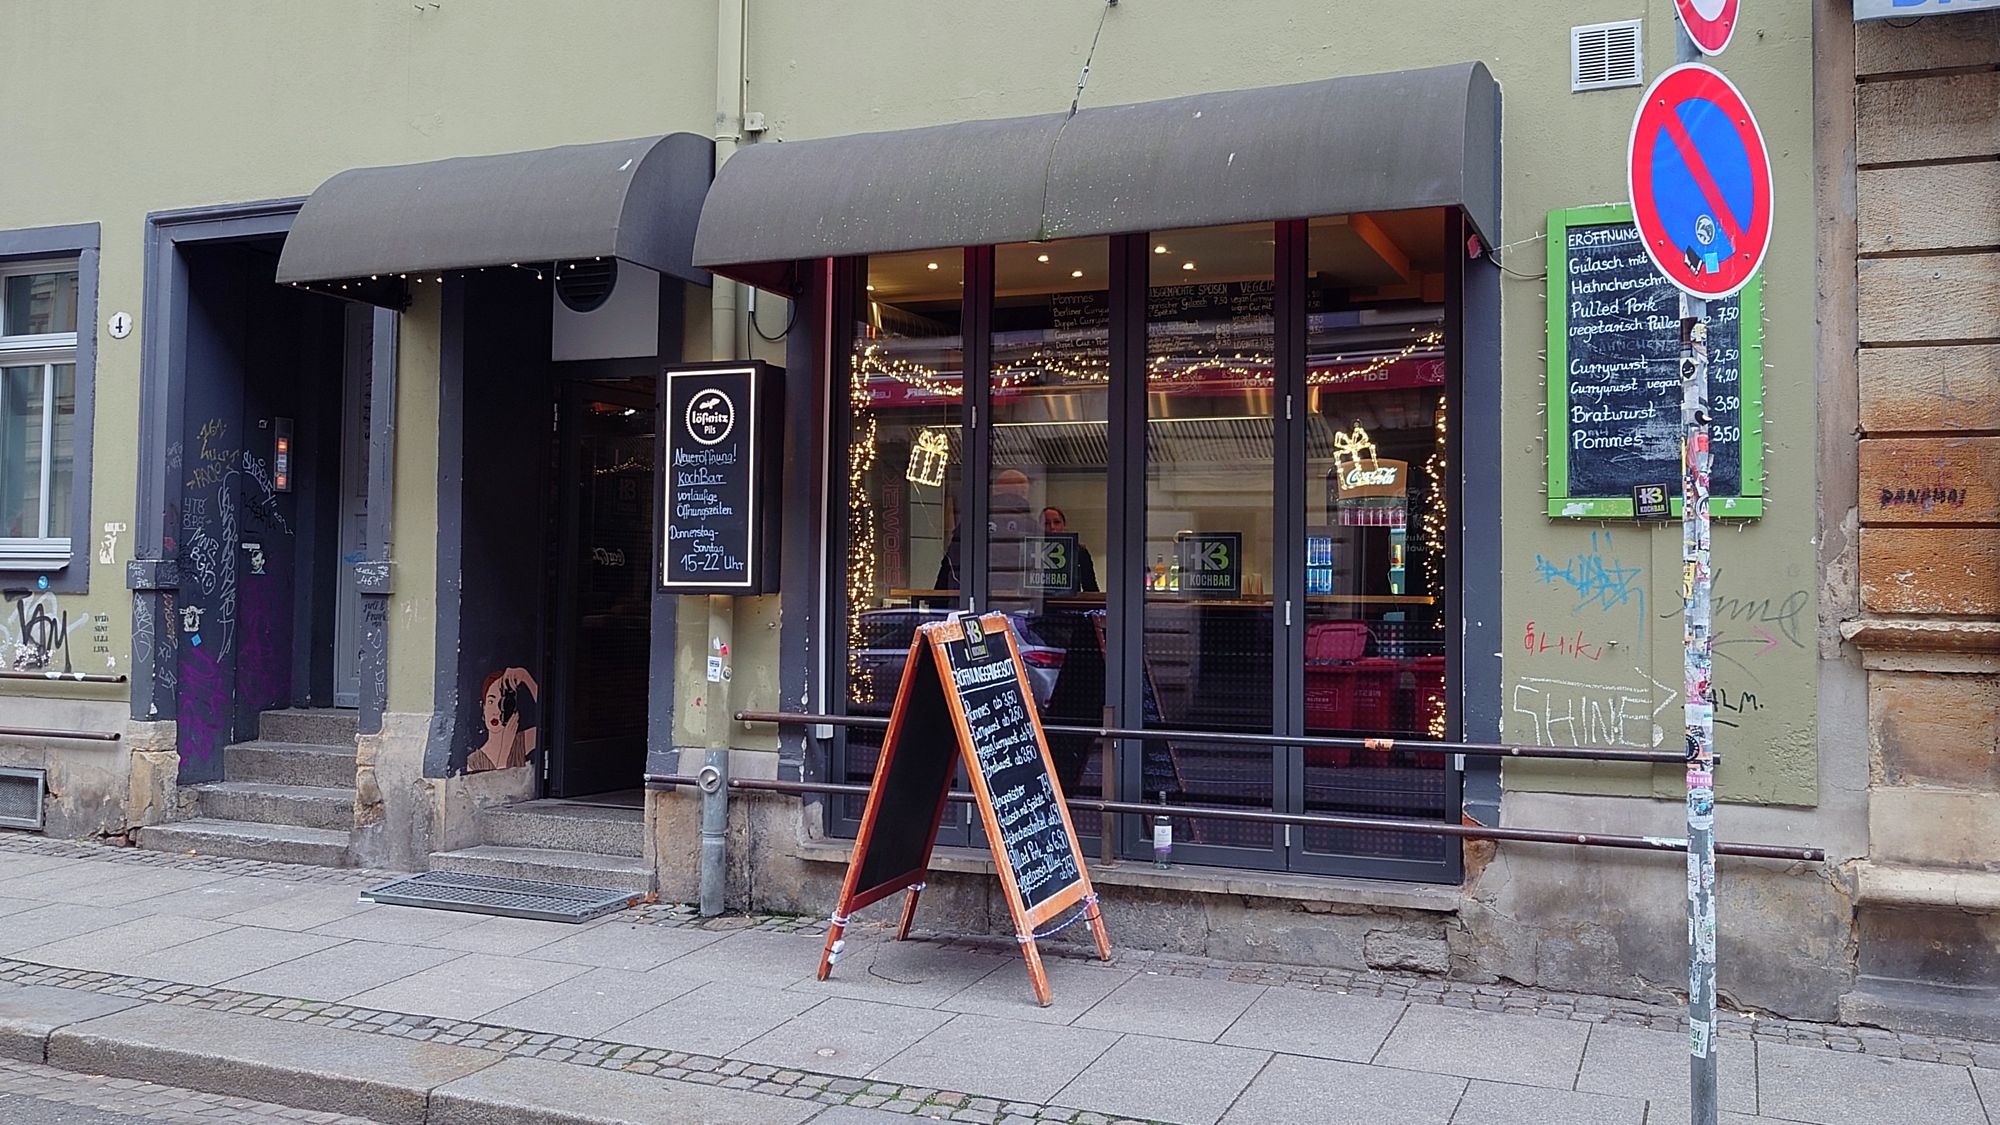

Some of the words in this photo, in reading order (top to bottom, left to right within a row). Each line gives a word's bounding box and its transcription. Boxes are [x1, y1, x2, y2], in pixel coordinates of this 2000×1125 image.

[1568, 228, 1639, 247] ERÖFFNUNG
[1569, 255, 1624, 274] Gulasch
[1628, 252, 1648, 266] mit
[1571, 273, 1671, 295] Hähnchenschn
[1571, 298, 1619, 318] Pulled
[1625, 296, 1658, 315] Pork
[1569, 318, 1643, 343] vegetarisch
[1717, 307, 1739, 323] 7,50
[1570, 354, 1648, 382] Currywurst
[1713, 350, 1739, 363] 2,50
[1570, 378, 1638, 404] Currywurst
[1647, 380, 1682, 395] vegan
[1715, 368, 1738, 382] 4,20
[1571, 401, 1656, 423] Bratwurst
[1714, 396, 1740, 413] 3,50
[704, 425, 716, 435] Pils
[1572, 430, 1643, 449] Pommes
[1712, 425, 1740, 443] 3,50
[673, 444, 737, 466] Neueröffnung!
[677, 489, 718, 504] vorläufige
[677, 502, 733, 520] Öffnungszeiten
[692, 540, 724, 555] Sonntag
[680, 553, 720, 572] 15-22
[724, 554, 744, 571] Uhr
[1030, 573, 1067, 585] KOCHBAR
[1190, 574, 1230, 586] KOCHBAR
[992, 695, 1002, 709] ab
[1002, 714, 1010, 727] ab
[1015, 754, 1023, 766] ab
[1046, 841, 1054, 853] ab
